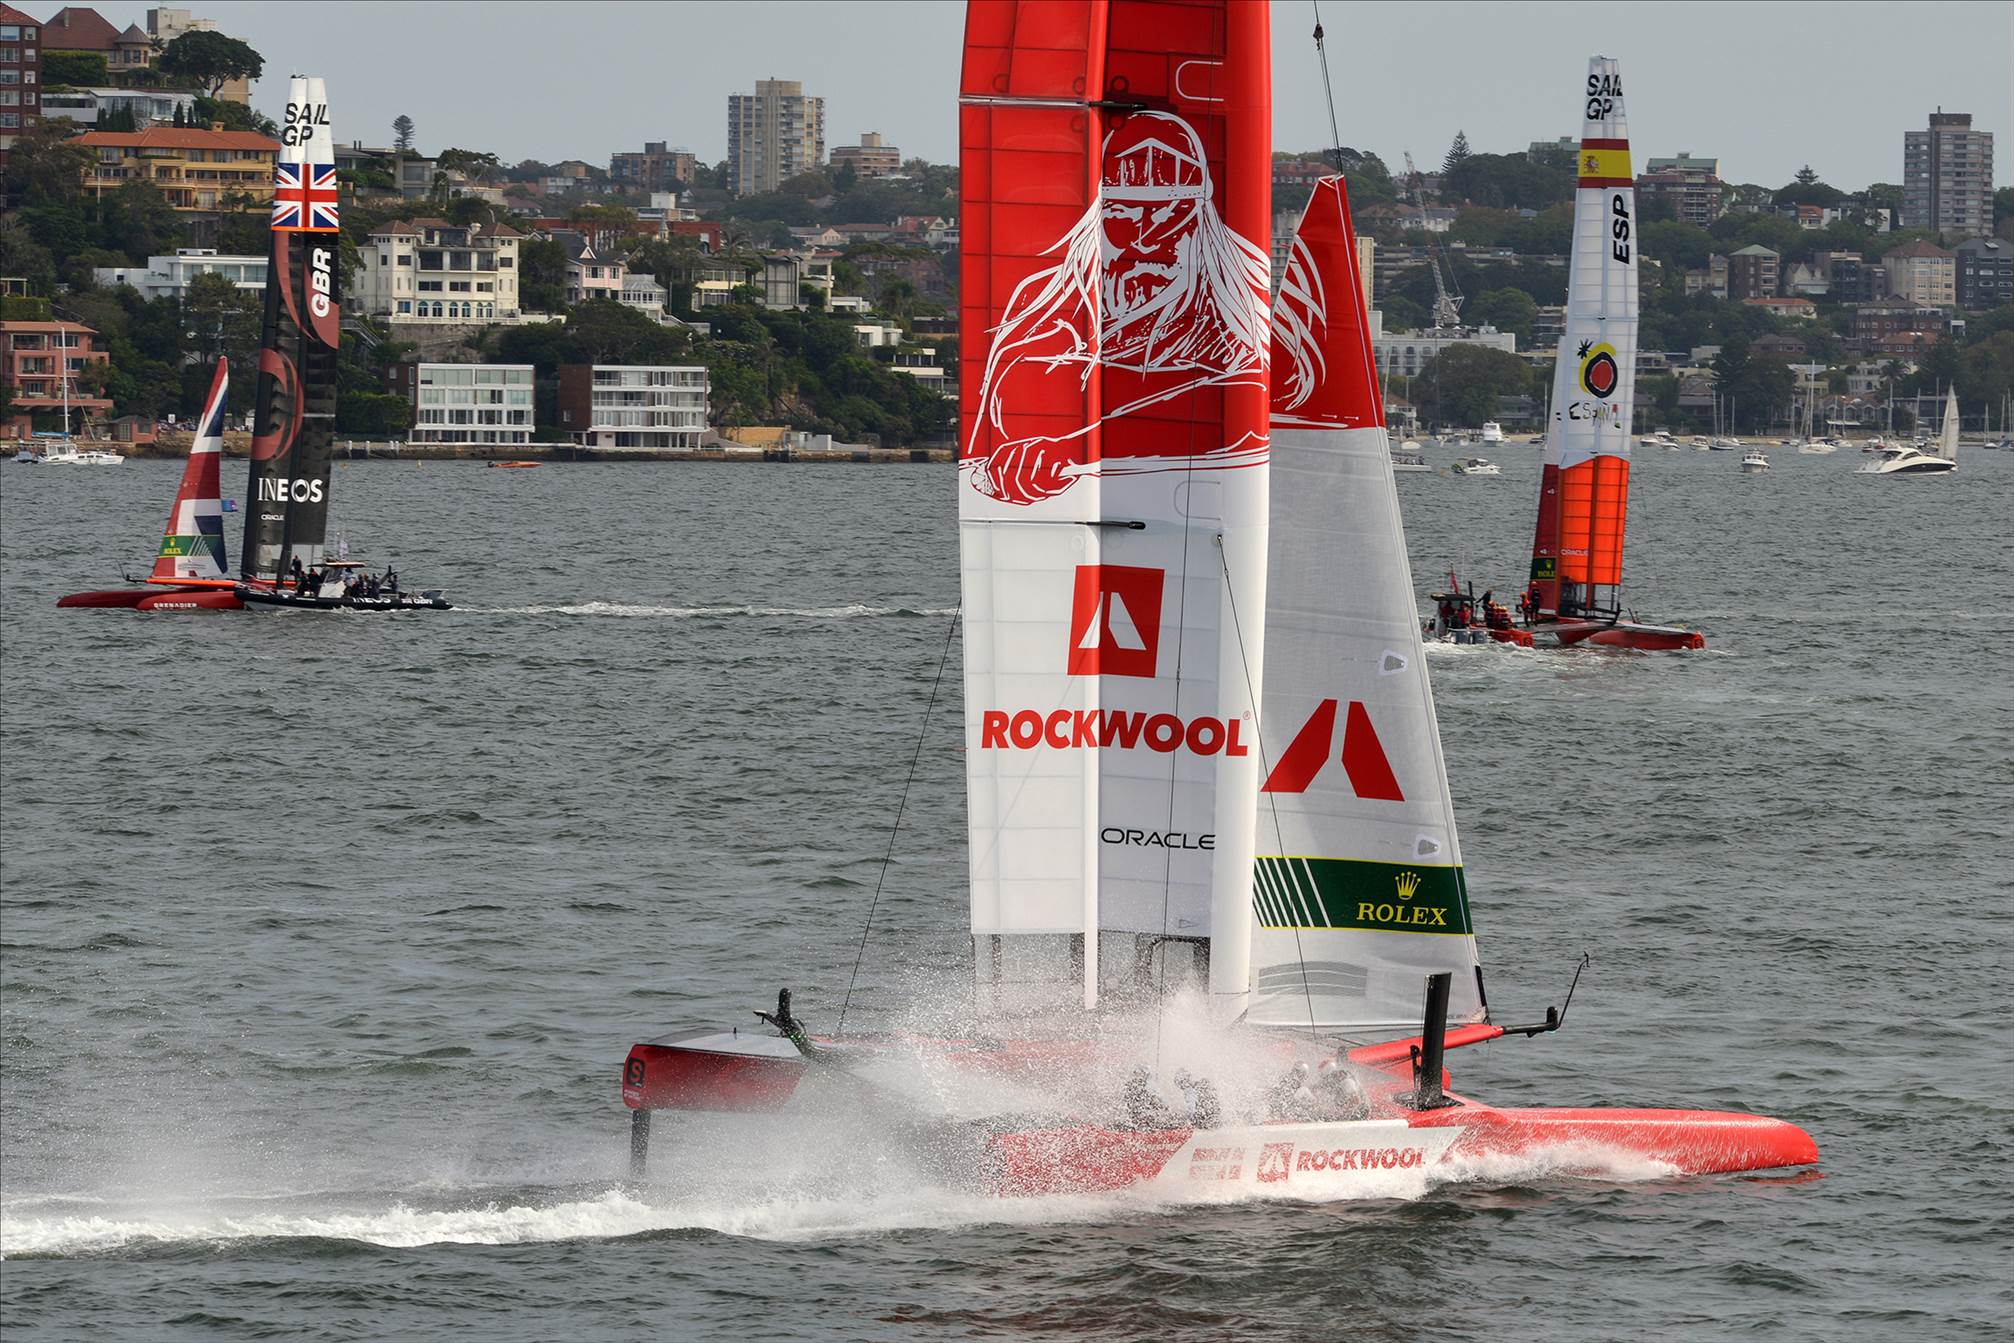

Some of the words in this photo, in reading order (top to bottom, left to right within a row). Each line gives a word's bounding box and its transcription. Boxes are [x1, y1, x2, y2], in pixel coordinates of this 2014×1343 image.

[1587, 75, 1623, 96] SAIL
[285, 103, 330, 126] SAIL
[1586, 98, 1613, 120] GP
[282, 125, 313, 147] GP
[1613, 194, 1630, 264] ESP
[312, 248, 331, 317] GBR
[257, 477, 323, 503] INEOS
[981, 709, 1249, 757] ROCKWOOL
[1101, 828, 1216, 850] ORACLE
[1356, 902, 1447, 926] ROLEX
[1296, 1147, 1425, 1171] ROCKWOOL
